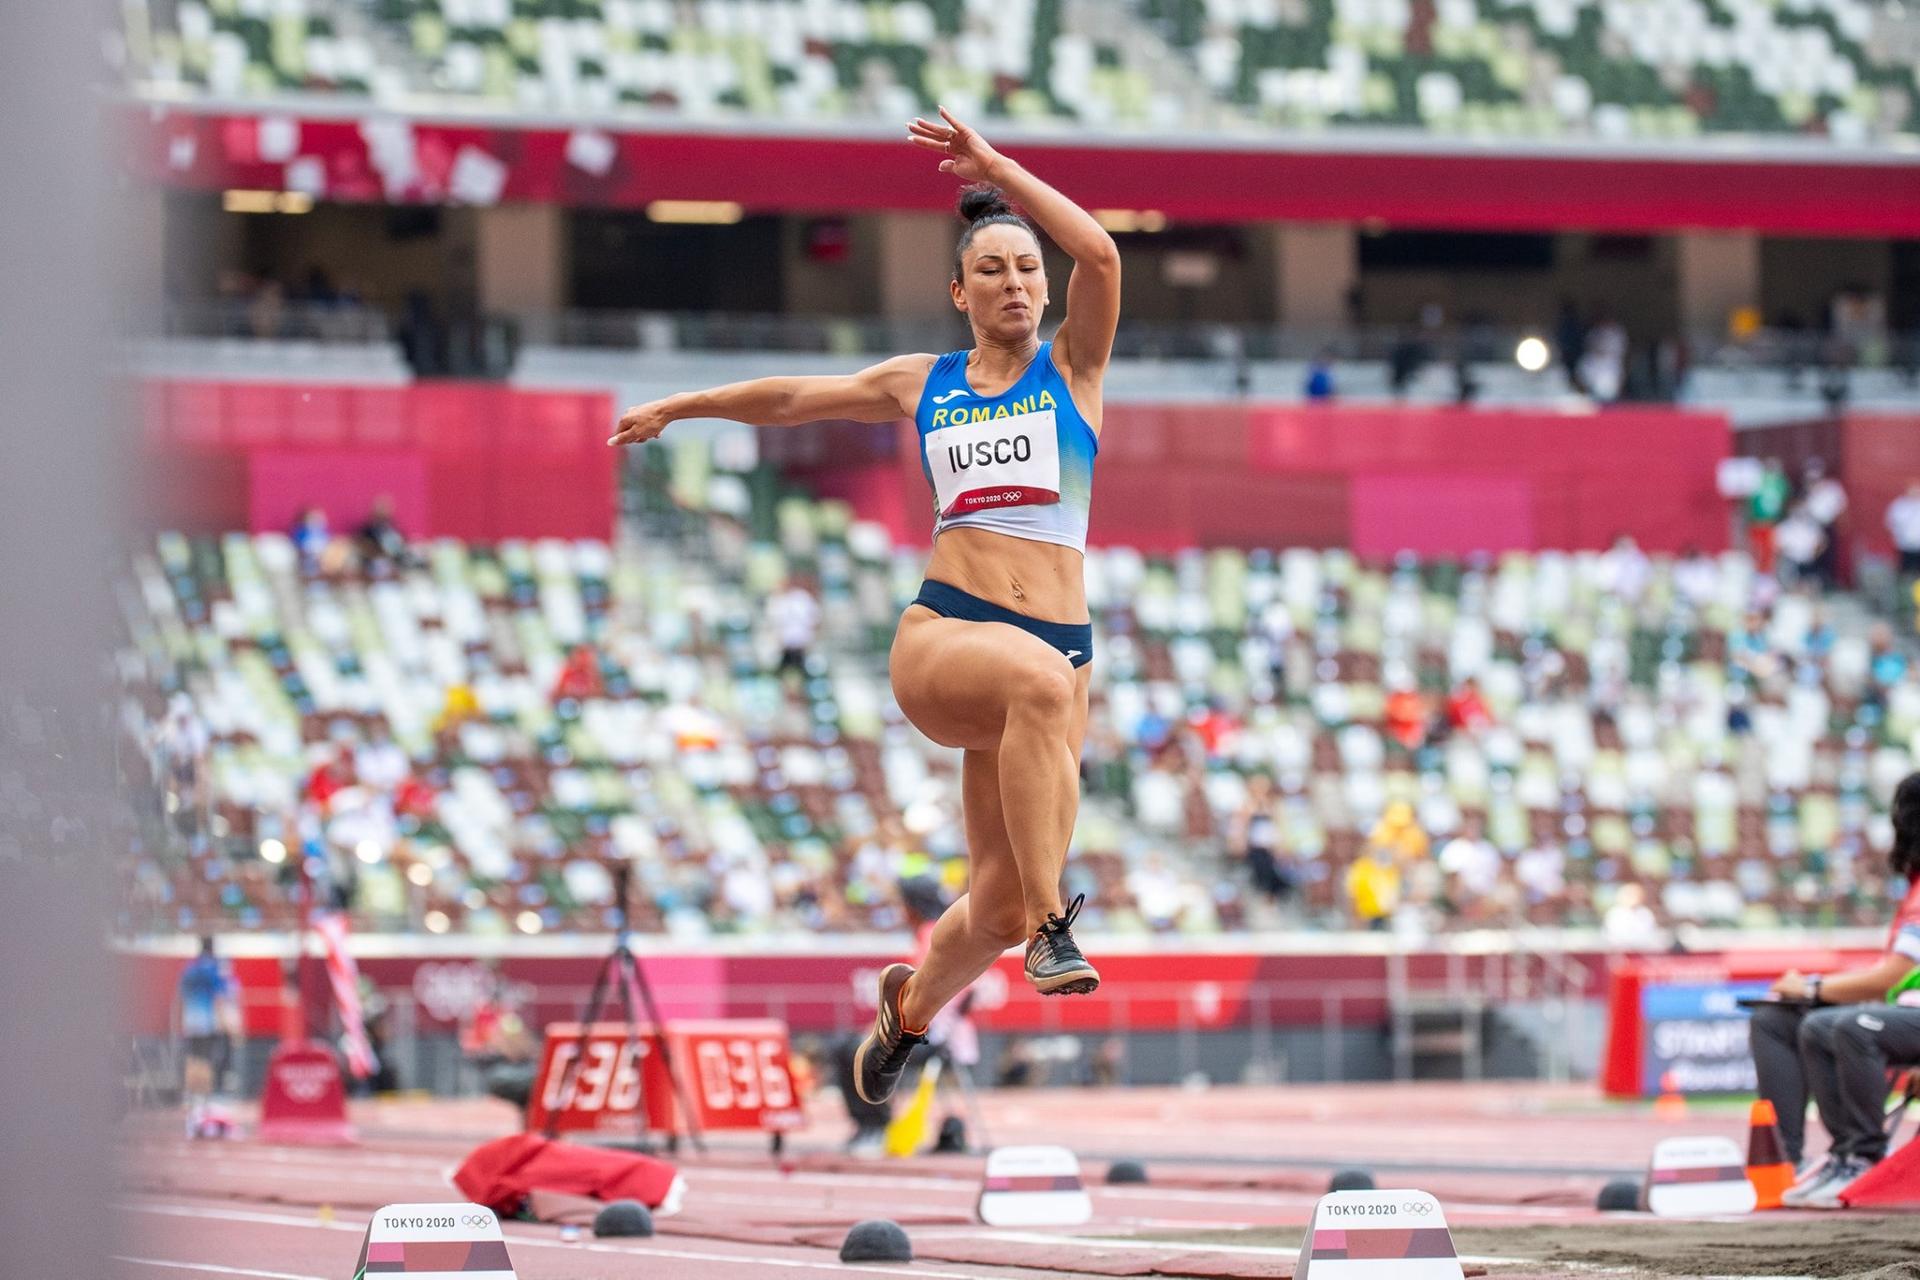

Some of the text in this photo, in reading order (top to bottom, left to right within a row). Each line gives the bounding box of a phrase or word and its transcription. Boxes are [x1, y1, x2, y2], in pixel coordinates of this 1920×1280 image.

[932, 389, 1057, 428] ROMANIA
[948, 434, 1031, 473] IUSCO
[965, 494, 1002, 505] TOKYO 2020
[1327, 1204, 1397, 1216] TOKYO 2020
[384, 1217, 455, 1229] TOKYO 2020
